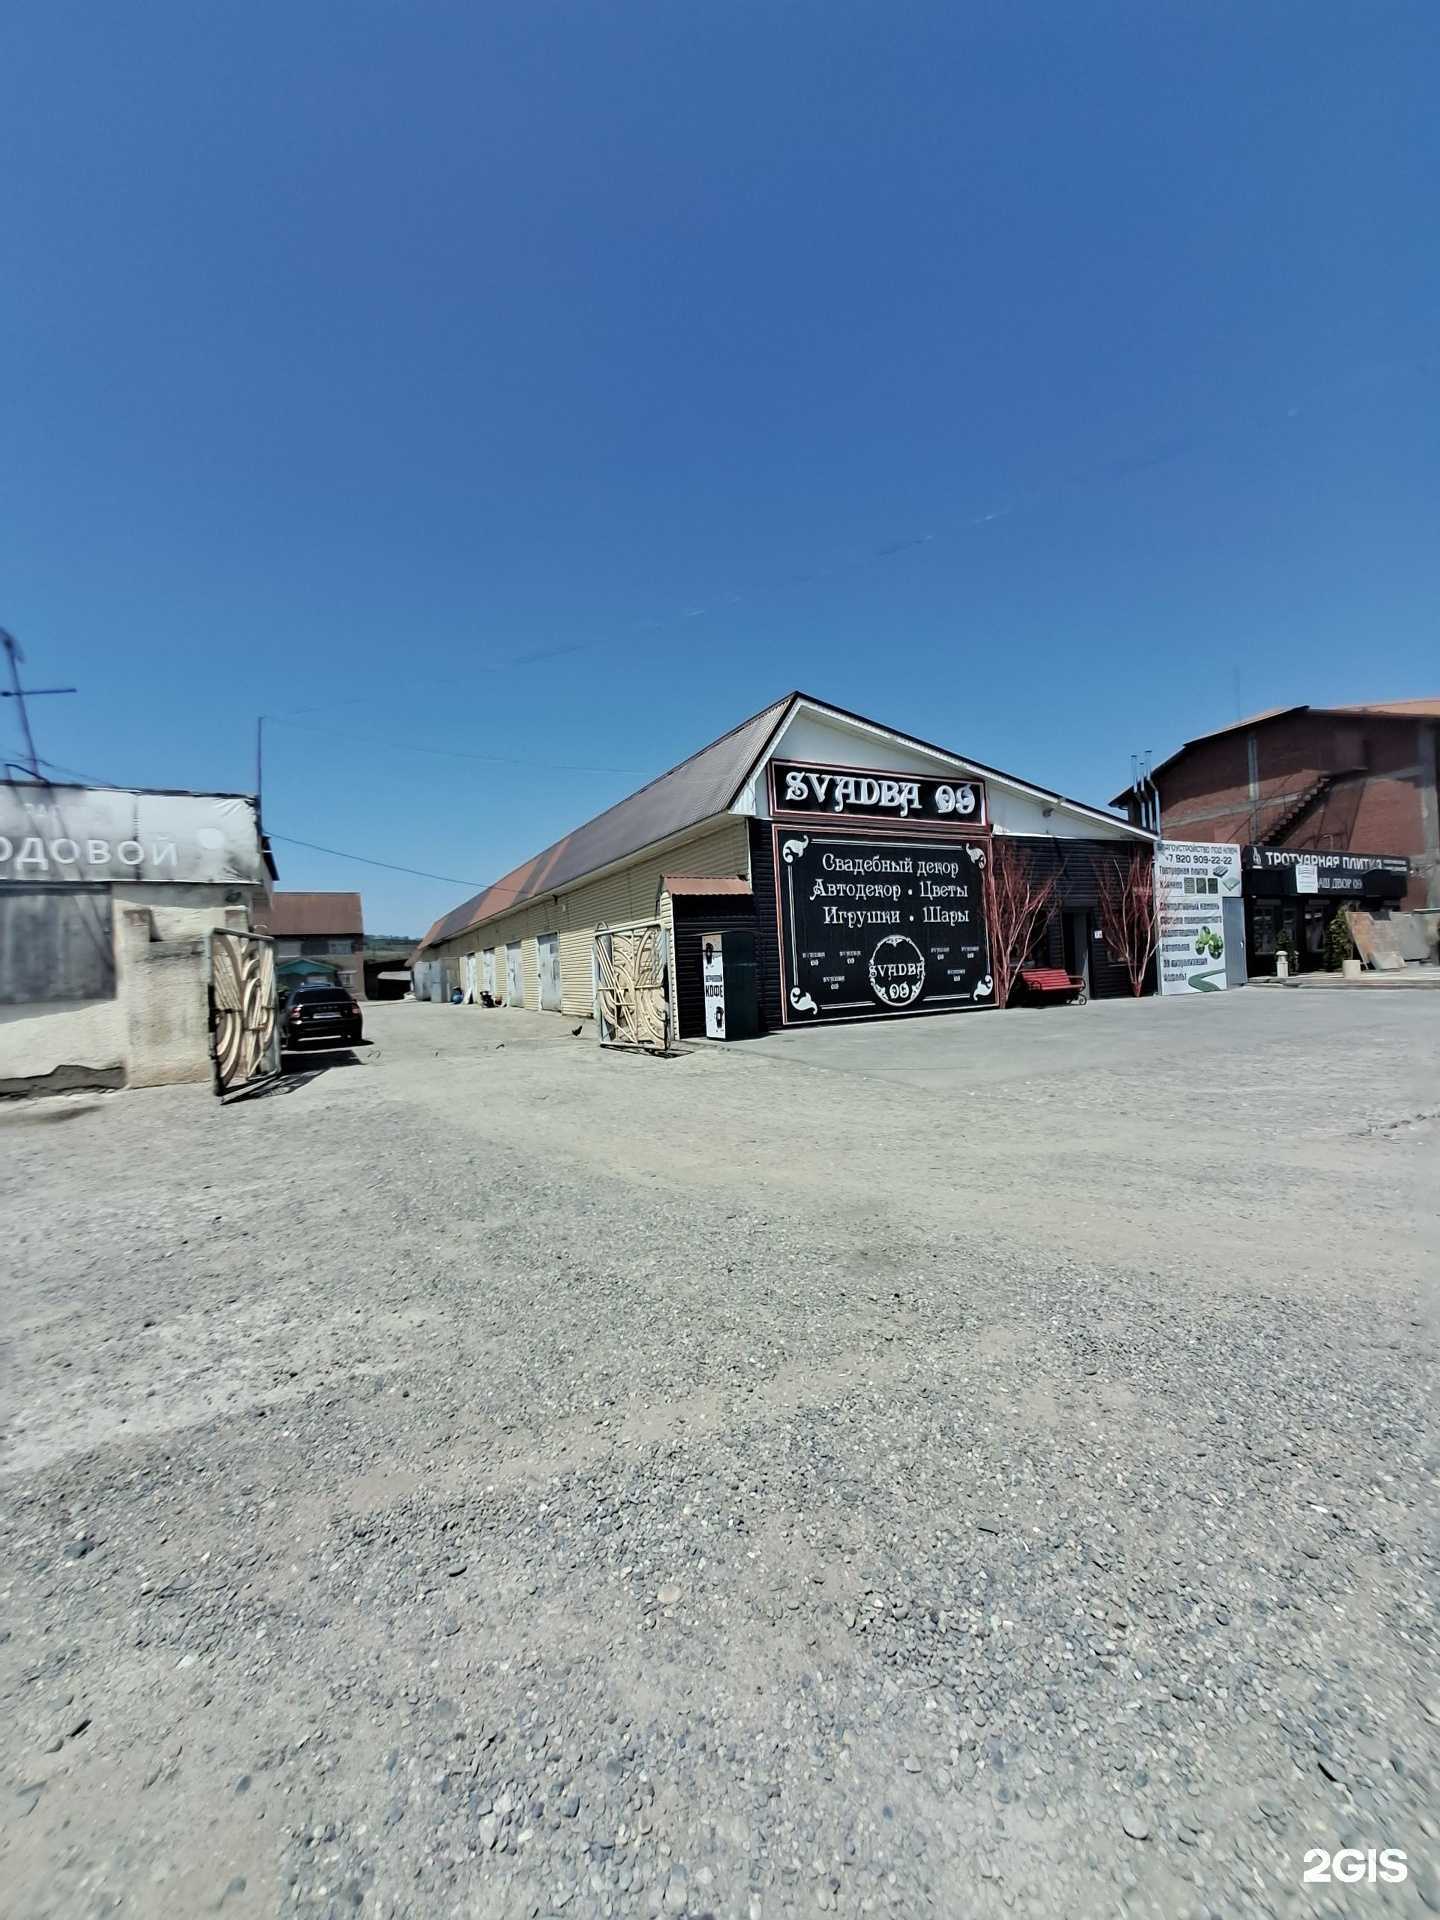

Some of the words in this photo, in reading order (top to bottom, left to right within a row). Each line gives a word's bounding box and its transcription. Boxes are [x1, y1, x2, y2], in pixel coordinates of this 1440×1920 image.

[785, 771, 923, 818] SVADBA
[822, 852, 914, 876] Свадебный
[916, 860, 959, 878] декор
[1175, 854, 1191, 864] 920
[1193, 855, 1233, 864] 909-22-22
[1265, 852, 1340, 869] ТРОТУАРНАЯ
[1342, 857, 1382, 870] ПЛИТКА
[809, 878, 902, 902] Автодекор
[919, 880, 969, 901] Цветы
[1331, 878, 1353, 889] ДВОР
[822, 906, 901, 929] Игрушки
[923, 906, 970, 927] Шары
[868, 963, 926, 981] SVADBA
[705, 984, 724, 998] КОФЕ
[889, 981, 909, 999] 09
